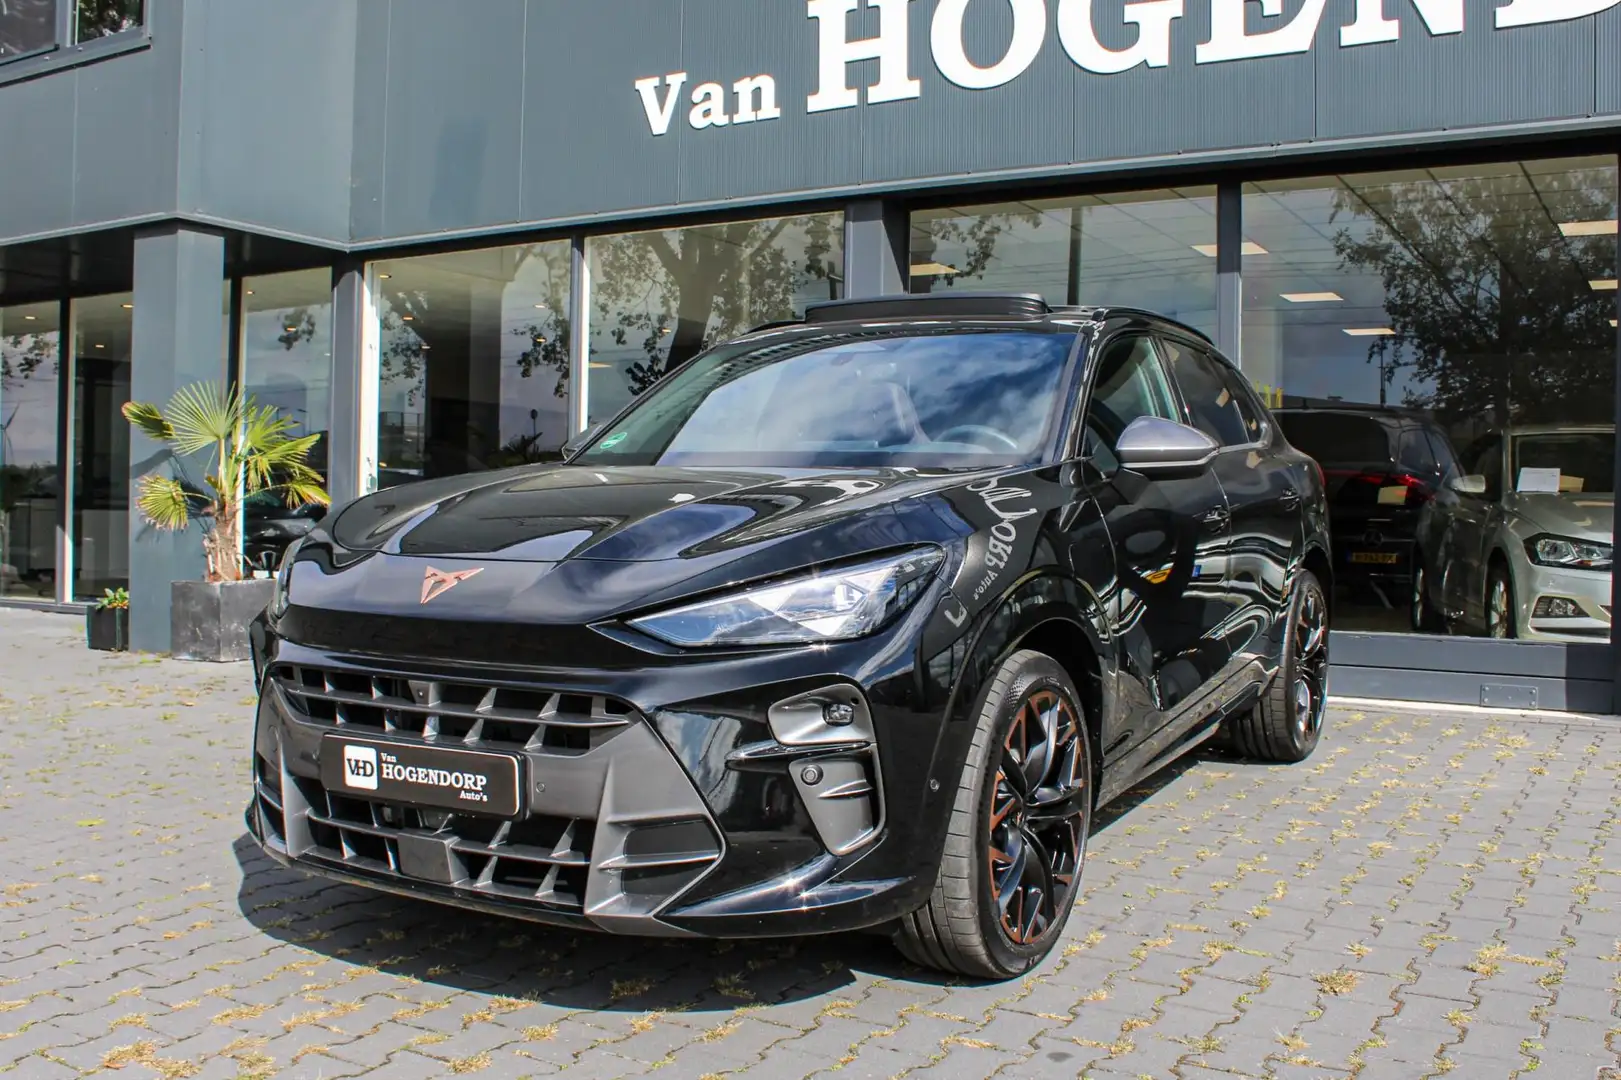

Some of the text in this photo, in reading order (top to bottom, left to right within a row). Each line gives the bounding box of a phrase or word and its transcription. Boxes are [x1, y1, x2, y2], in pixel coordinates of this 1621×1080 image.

[635, 0, 1621, 136] Van HOG
[346, 757, 375, 778] VHD
[380, 752, 397, 763] Van
[381, 764, 487, 790] HOGENDORP
[459, 790, 488, 802] Auto's
